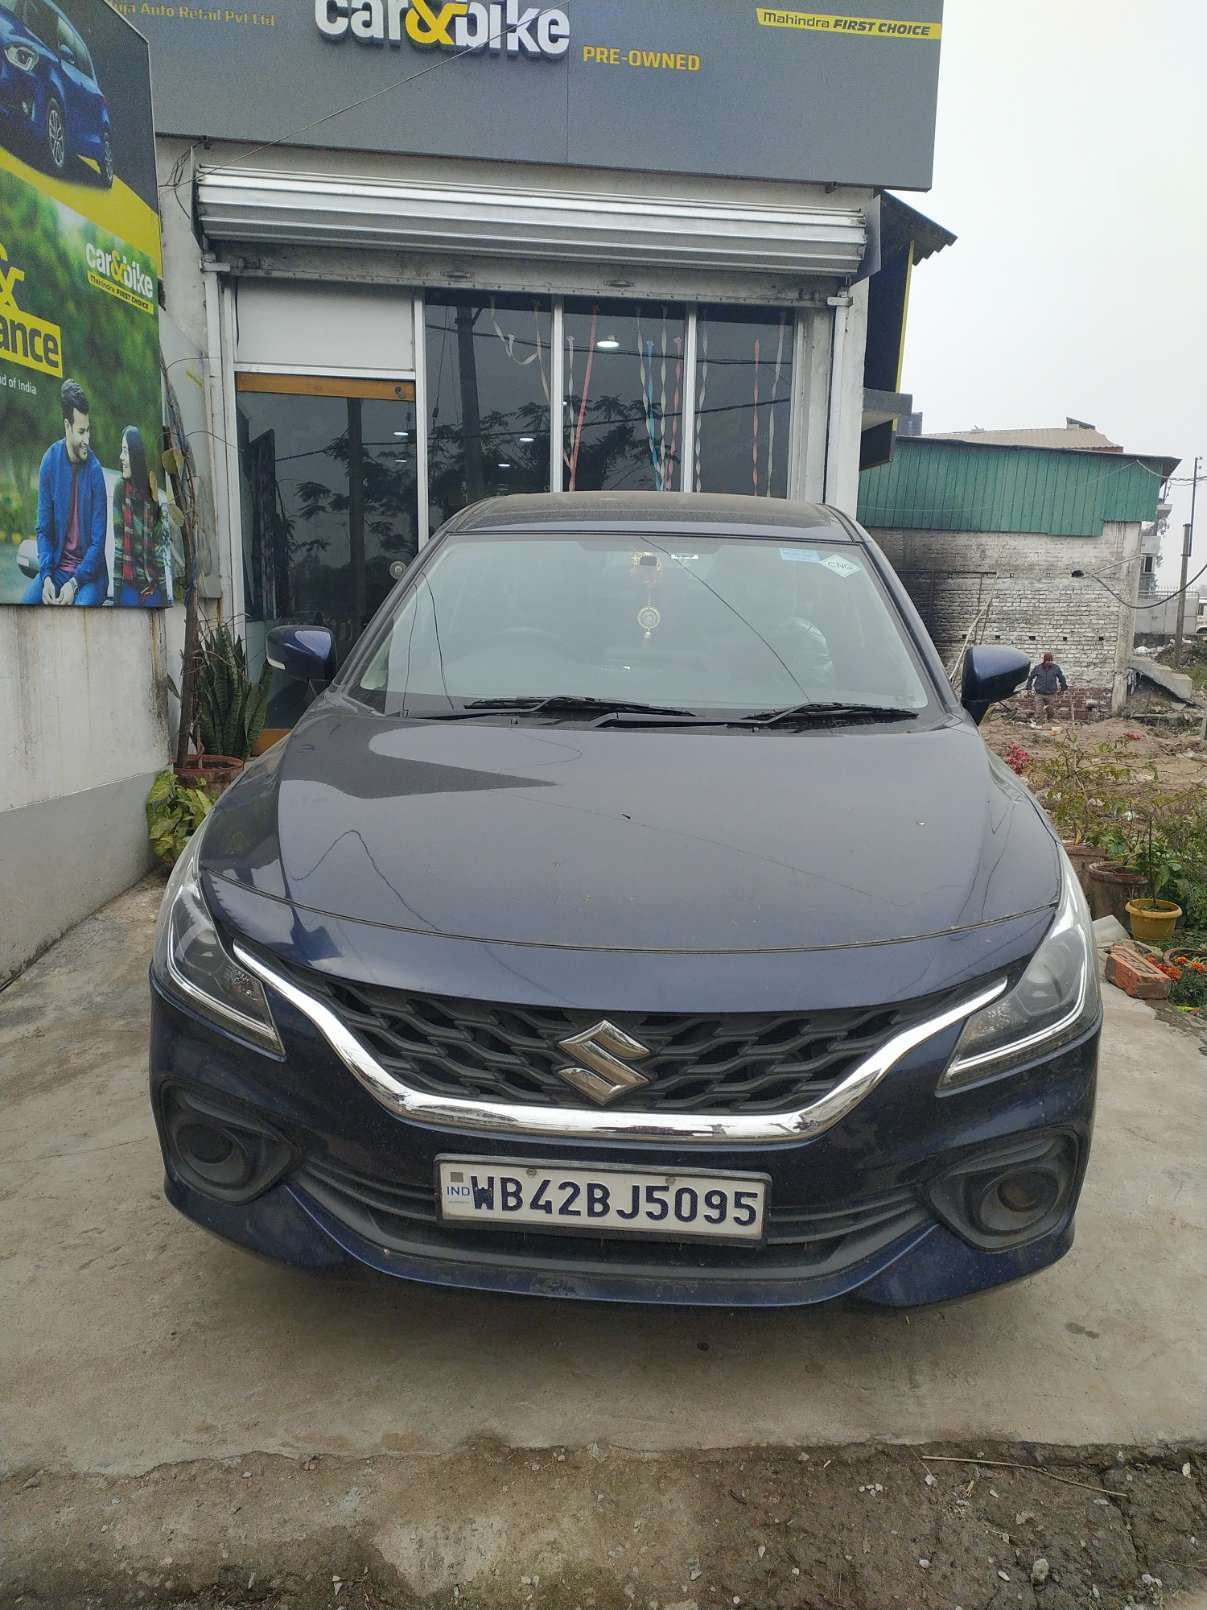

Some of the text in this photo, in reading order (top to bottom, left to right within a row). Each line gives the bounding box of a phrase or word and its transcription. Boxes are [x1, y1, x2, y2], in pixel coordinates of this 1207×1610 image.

[140, 3, 175, 17] Auto
[179, 6, 221, 21] Retail
[224, 10, 248, 24] Pvt
[253, 13, 275, 26] Ltd
[763, 11, 931, 37] Mahindra FIRST CHOICE
[583, 45, 701, 71] PRE-OWNED
[86, 243, 153, 298] car&bike
[8, 377, 17, 389] of
[18, 380, 37, 395] India
[446, 1186, 470, 1197] IND
[470, 1175, 759, 1226] WB42BJ5095
